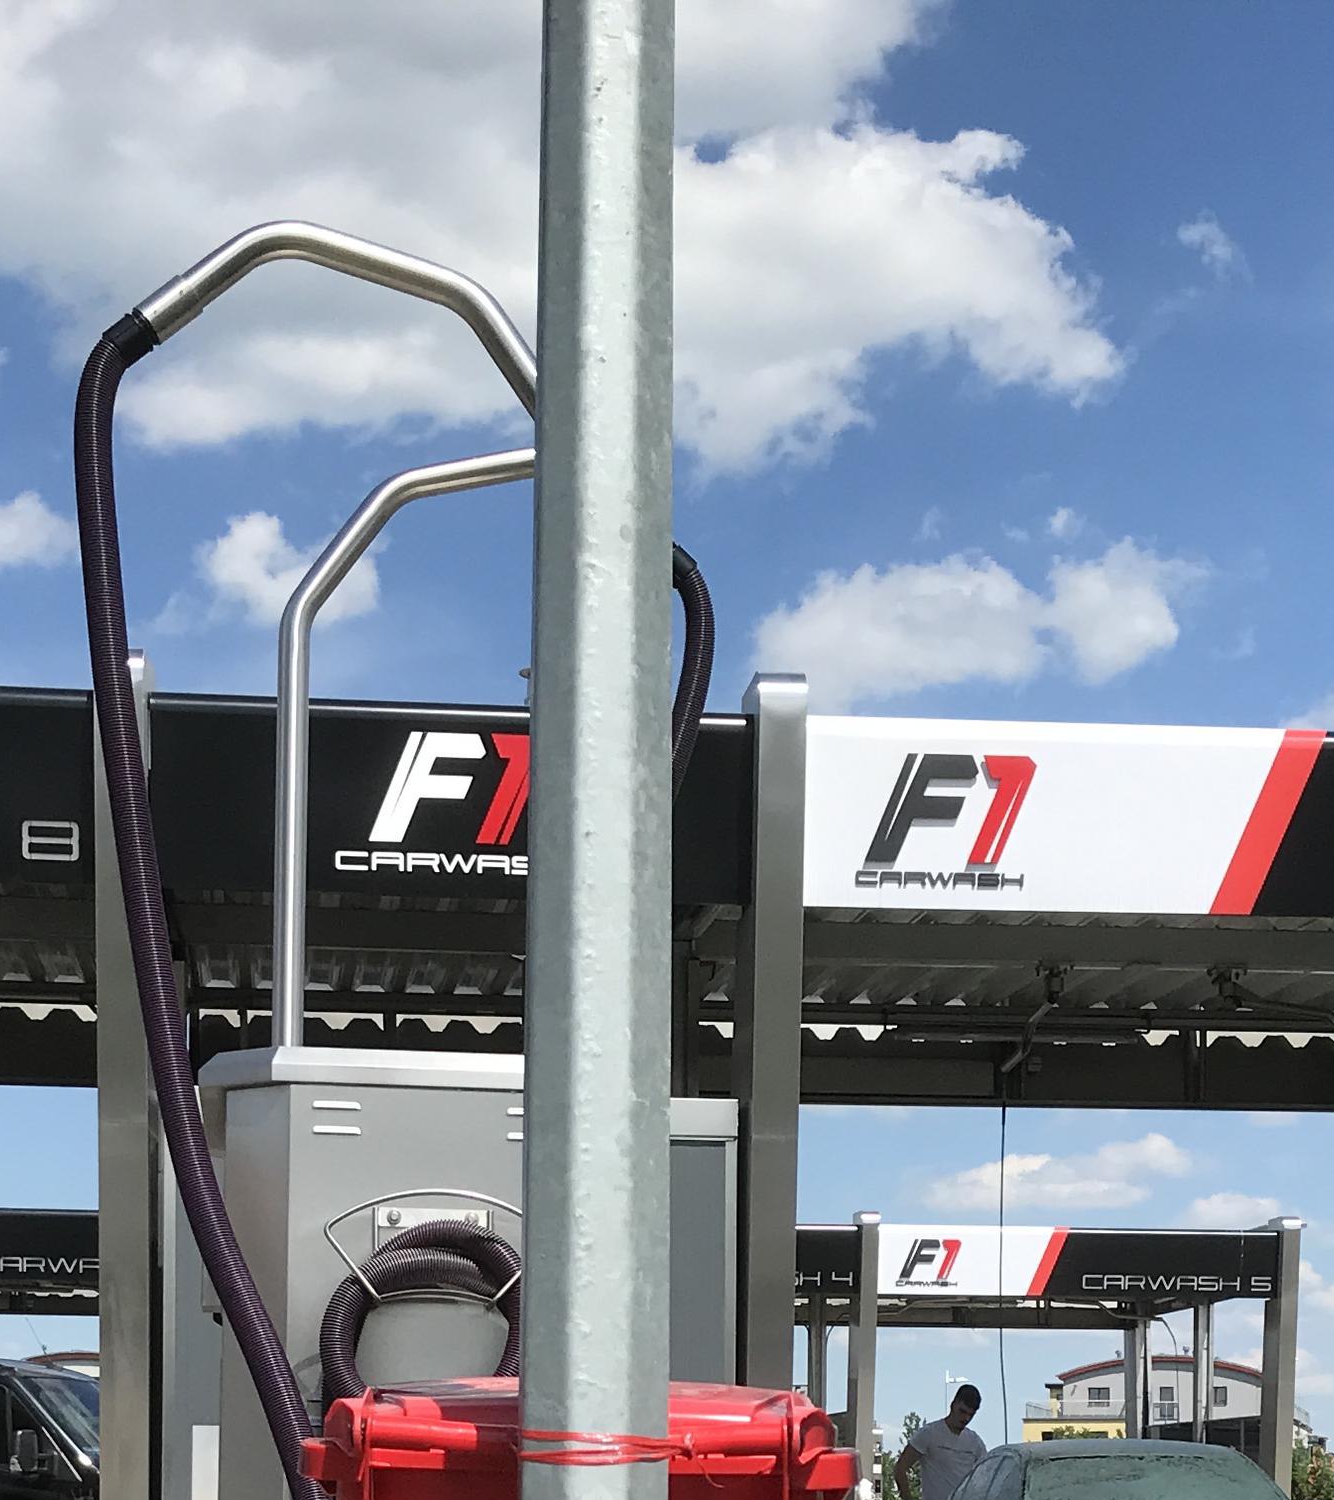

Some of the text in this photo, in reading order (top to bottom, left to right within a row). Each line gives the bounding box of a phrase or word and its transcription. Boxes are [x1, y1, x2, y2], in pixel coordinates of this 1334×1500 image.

[368, 731, 531, 846] F1
[864, 753, 1038, 865] F1
[21, 818, 81, 862] 8
[854, 869, 1025, 890] CARWASH
[831, 1271, 854, 1287] 4
[898, 1238, 963, 1281] F1
[1081, 1274, 1273, 1292] CARWASH 5
